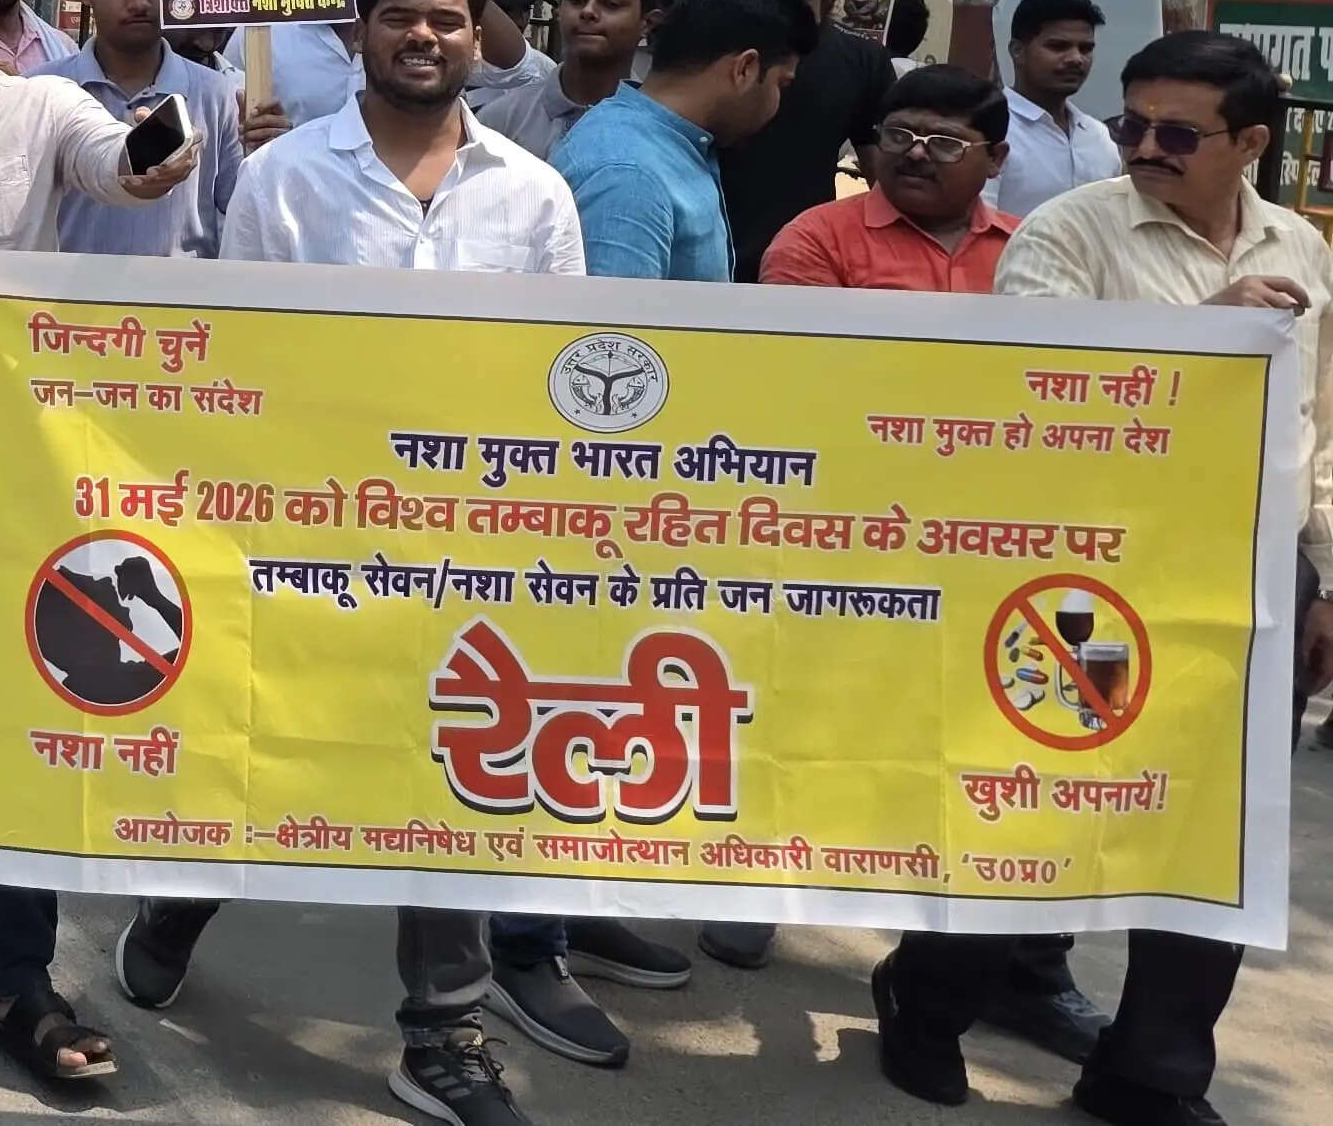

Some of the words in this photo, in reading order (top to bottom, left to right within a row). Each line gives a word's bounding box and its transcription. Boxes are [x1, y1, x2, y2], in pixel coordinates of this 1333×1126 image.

[29, 313, 145, 359] जिन्दगी
[157, 319, 211, 373] चुनें
[147, 381, 181, 413] का
[193, 379, 263, 416] संदेश
[1026, 369, 1089, 404] नशा
[1100, 366, 1160, 409] नहीं
[391, 432, 468, 472] नशा
[479, 435, 559, 487] मुक्त
[572, 440, 662, 480] भारत
[674, 435, 817, 487] अभियान
[868, 414, 925, 445] नशा
[935, 417, 995, 456] मुक्त
[1005, 413, 1034, 449] हो
[1042, 422, 1113, 452] अपना
[1124, 419, 1171, 456] देश
[76, 477, 110, 520] 31
[117, 470, 188, 527] मई
[196, 480, 275, 524] 2026
[284, 478, 348, 529] को
[356, 479, 460, 534] विश्व
[467, 497, 623, 559] तम्बाकू
[624, 493, 731, 547] रहित
[739, 497, 855, 553] दिवस
[863, 503, 907, 553] के
[917, 518, 1059, 561] अवसर
[1066, 525, 1126, 564] पर
[250, 559, 357, 610] तम्बाकू
[364, 553, 515, 609] सेवन/नशा
[524, 559, 597, 607] सेवन
[607, 564, 639, 609] के
[650, 567, 706, 614] प्रति
[718, 579, 772, 615] जन
[433, 618, 751, 818] रैली
[31, 729, 105, 771] नशा
[113, 726, 181, 776] नहीं
[961, 764, 1041, 822] खुशी
[1052, 772, 1168, 814] अपनायें!
[115, 812, 232, 848] आयोजक
[361, 820, 476, 857] मद्यनिषेध
[485, 823, 525, 862] एवं
[534, 827, 690, 867] समाजोत्थान
[700, 833, 812, 872] अधिकारी
[821, 843, 951, 884] वाराणसी,
